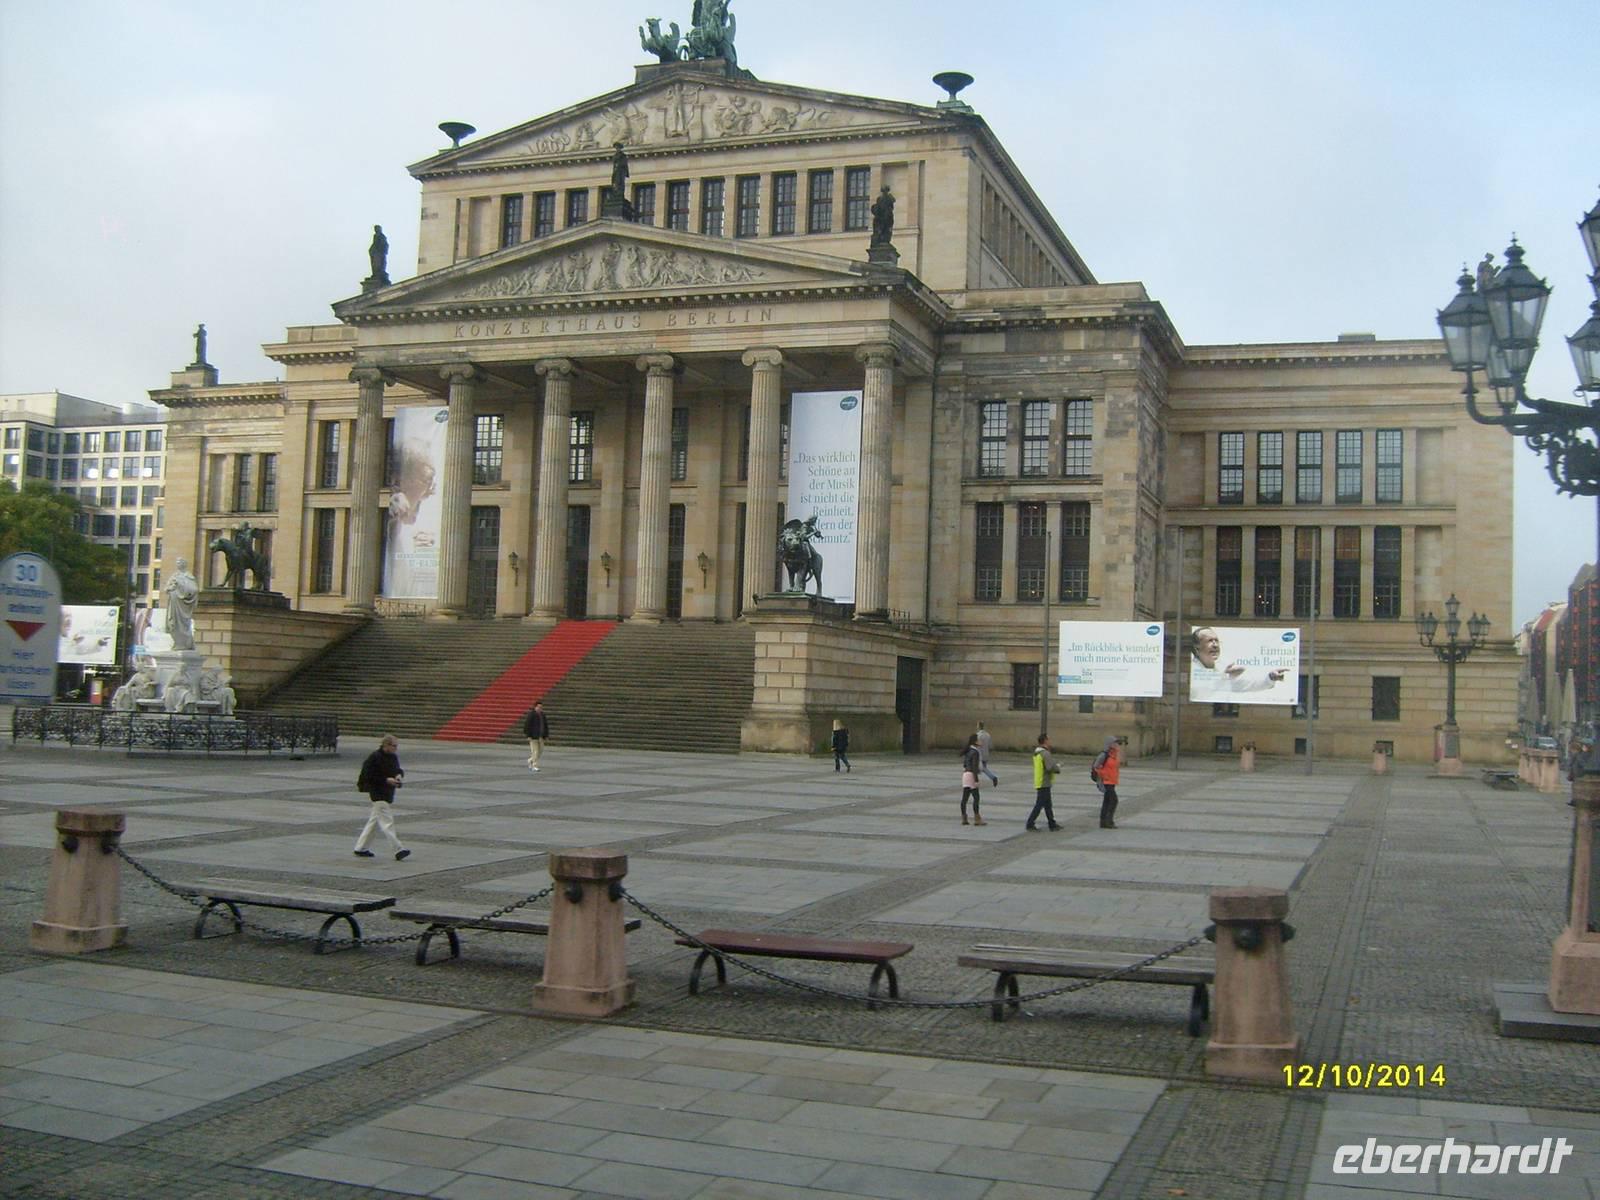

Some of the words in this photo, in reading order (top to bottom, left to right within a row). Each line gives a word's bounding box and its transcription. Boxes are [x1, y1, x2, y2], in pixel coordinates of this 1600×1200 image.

[454, 314, 642, 338] KONZERTHAUS
[666, 307, 773, 328] BERLIN
[818, 450, 856, 463] wirklich
[808, 465, 842, 477] Schöne
[809, 478, 825, 490] der
[828, 477, 855, 490] Musik
[800, 491, 812, 504] ist
[814, 491, 838, 504] nicht
[840, 491, 855, 503] die
[838, 519, 853, 530] der
[1084, 641, 1125, 653] Rückblick
[1125, 642, 1161, 654] wundert
[1260, 645, 1297, 656] Einmal
[1073, 652, 1095, 664] mich
[1096, 654, 1122, 664] meine
[1236, 655, 1261, 667] noch
[1263, 656, 1297, 668] Berlin!
